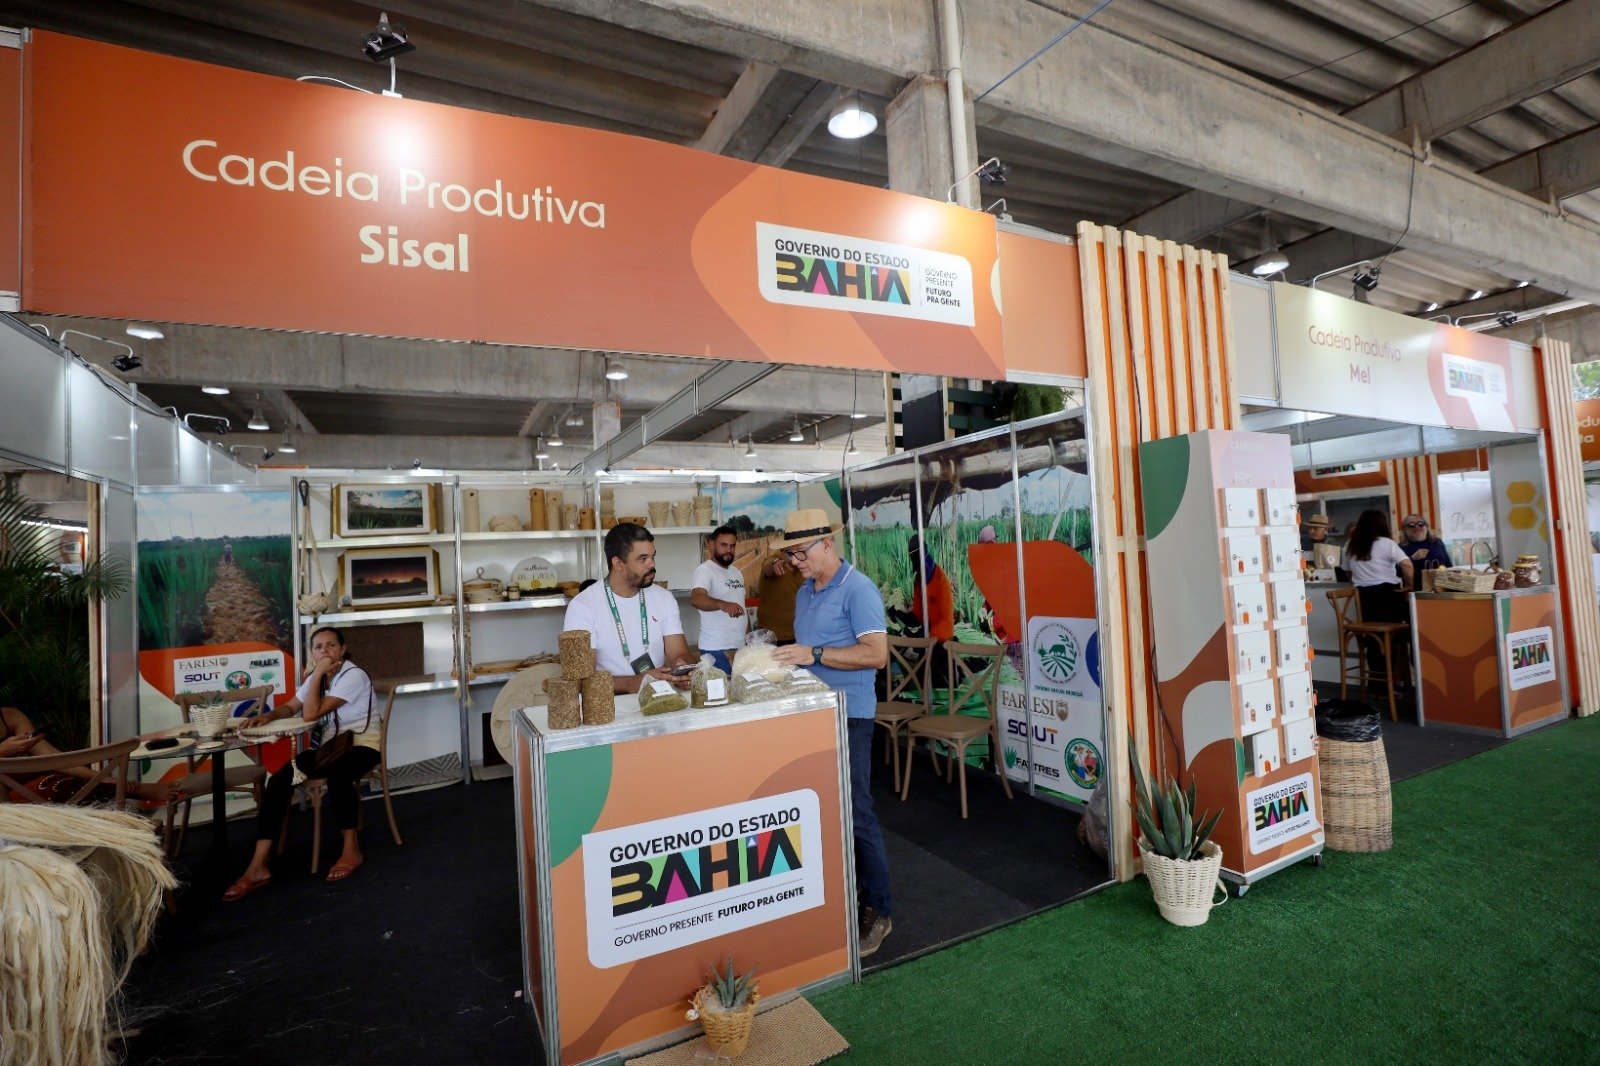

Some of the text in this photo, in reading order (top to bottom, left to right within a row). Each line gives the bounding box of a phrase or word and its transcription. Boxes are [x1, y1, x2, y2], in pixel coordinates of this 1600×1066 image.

[182, 139, 605, 229] Cadeia Produtiva
[359, 225, 470, 273] Sisal
[774, 238, 909, 269] GOVERNO DO ESTADO
[776, 252, 911, 306] BAHIA
[925, 268, 957, 280] GOVERNO
[926, 277, 954, 288] PRESENTE
[926, 287, 952, 298] FUTURO
[926, 295, 961, 307] PRA GENTE
[1308, 325, 1402, 362] Cadeia Produtiva
[1350, 363, 1371, 385] Mel
[179, 657, 218, 670] FARESI
[184, 671, 221, 683] SOUT
[1007, 719, 1057, 745] SOUT
[1254, 791, 1309, 832] BAHIA
[609, 806, 801, 863] GOVERNO DO ESTADO
[610, 827, 803, 917] BAHIA
[614, 886, 805, 947] GOVERNO PRESENTE FUTURO PRA GENTE
